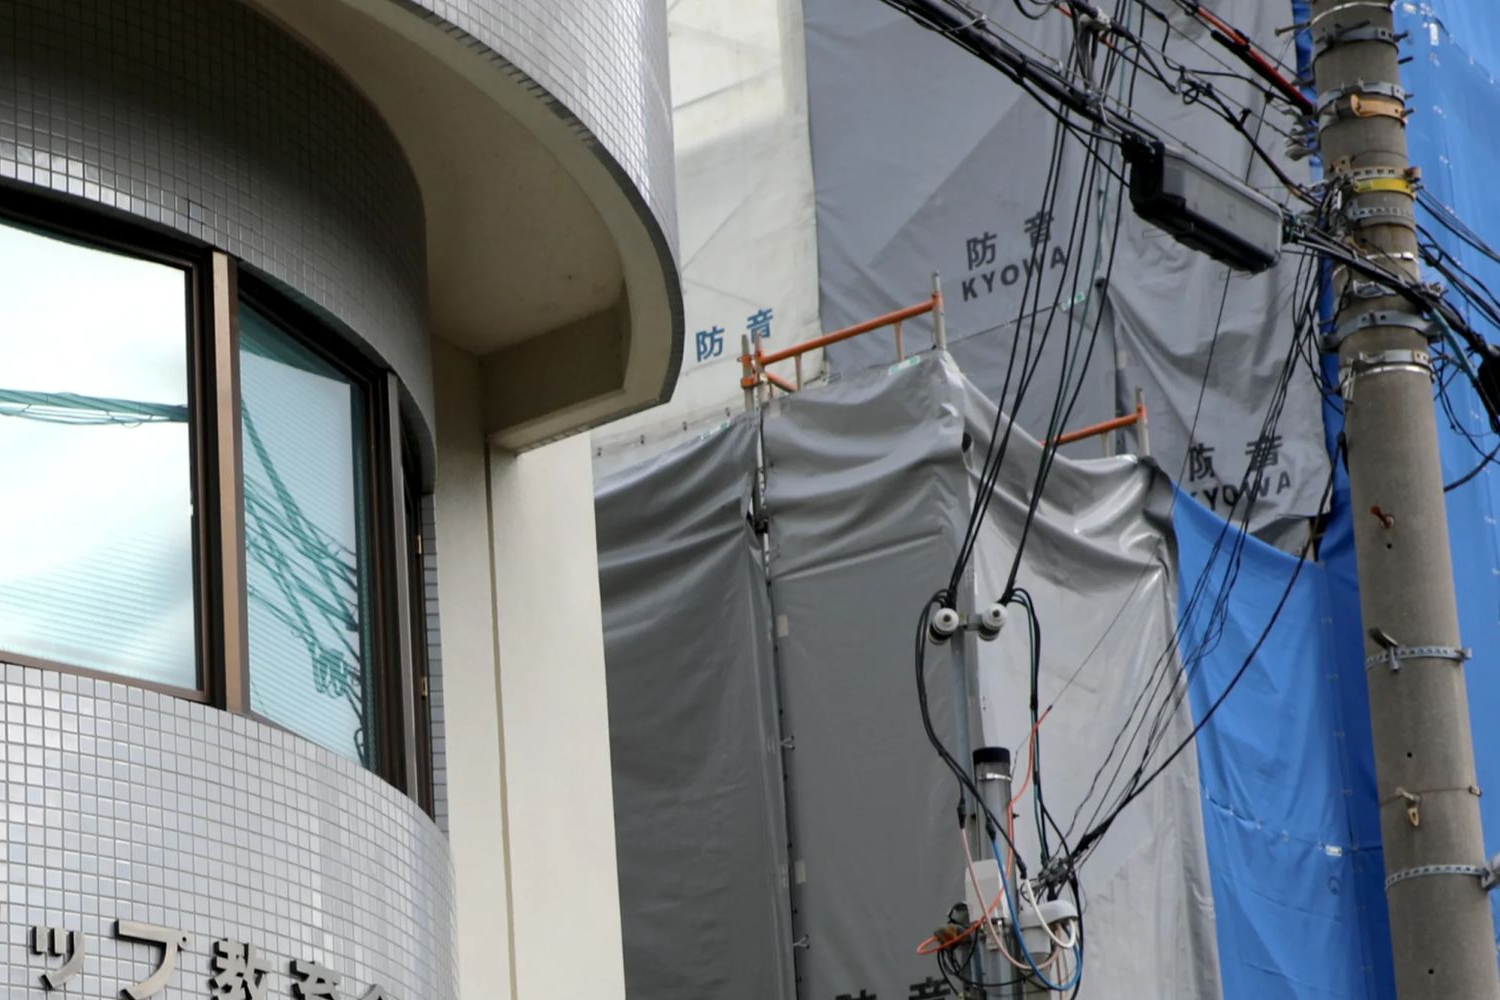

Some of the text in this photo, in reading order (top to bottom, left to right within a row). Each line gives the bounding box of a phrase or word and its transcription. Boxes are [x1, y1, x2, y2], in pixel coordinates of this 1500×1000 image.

[966, 211, 1054, 270] 防音
[961, 245, 1067, 302] KYOWA
[694, 308, 774, 363] 防音
